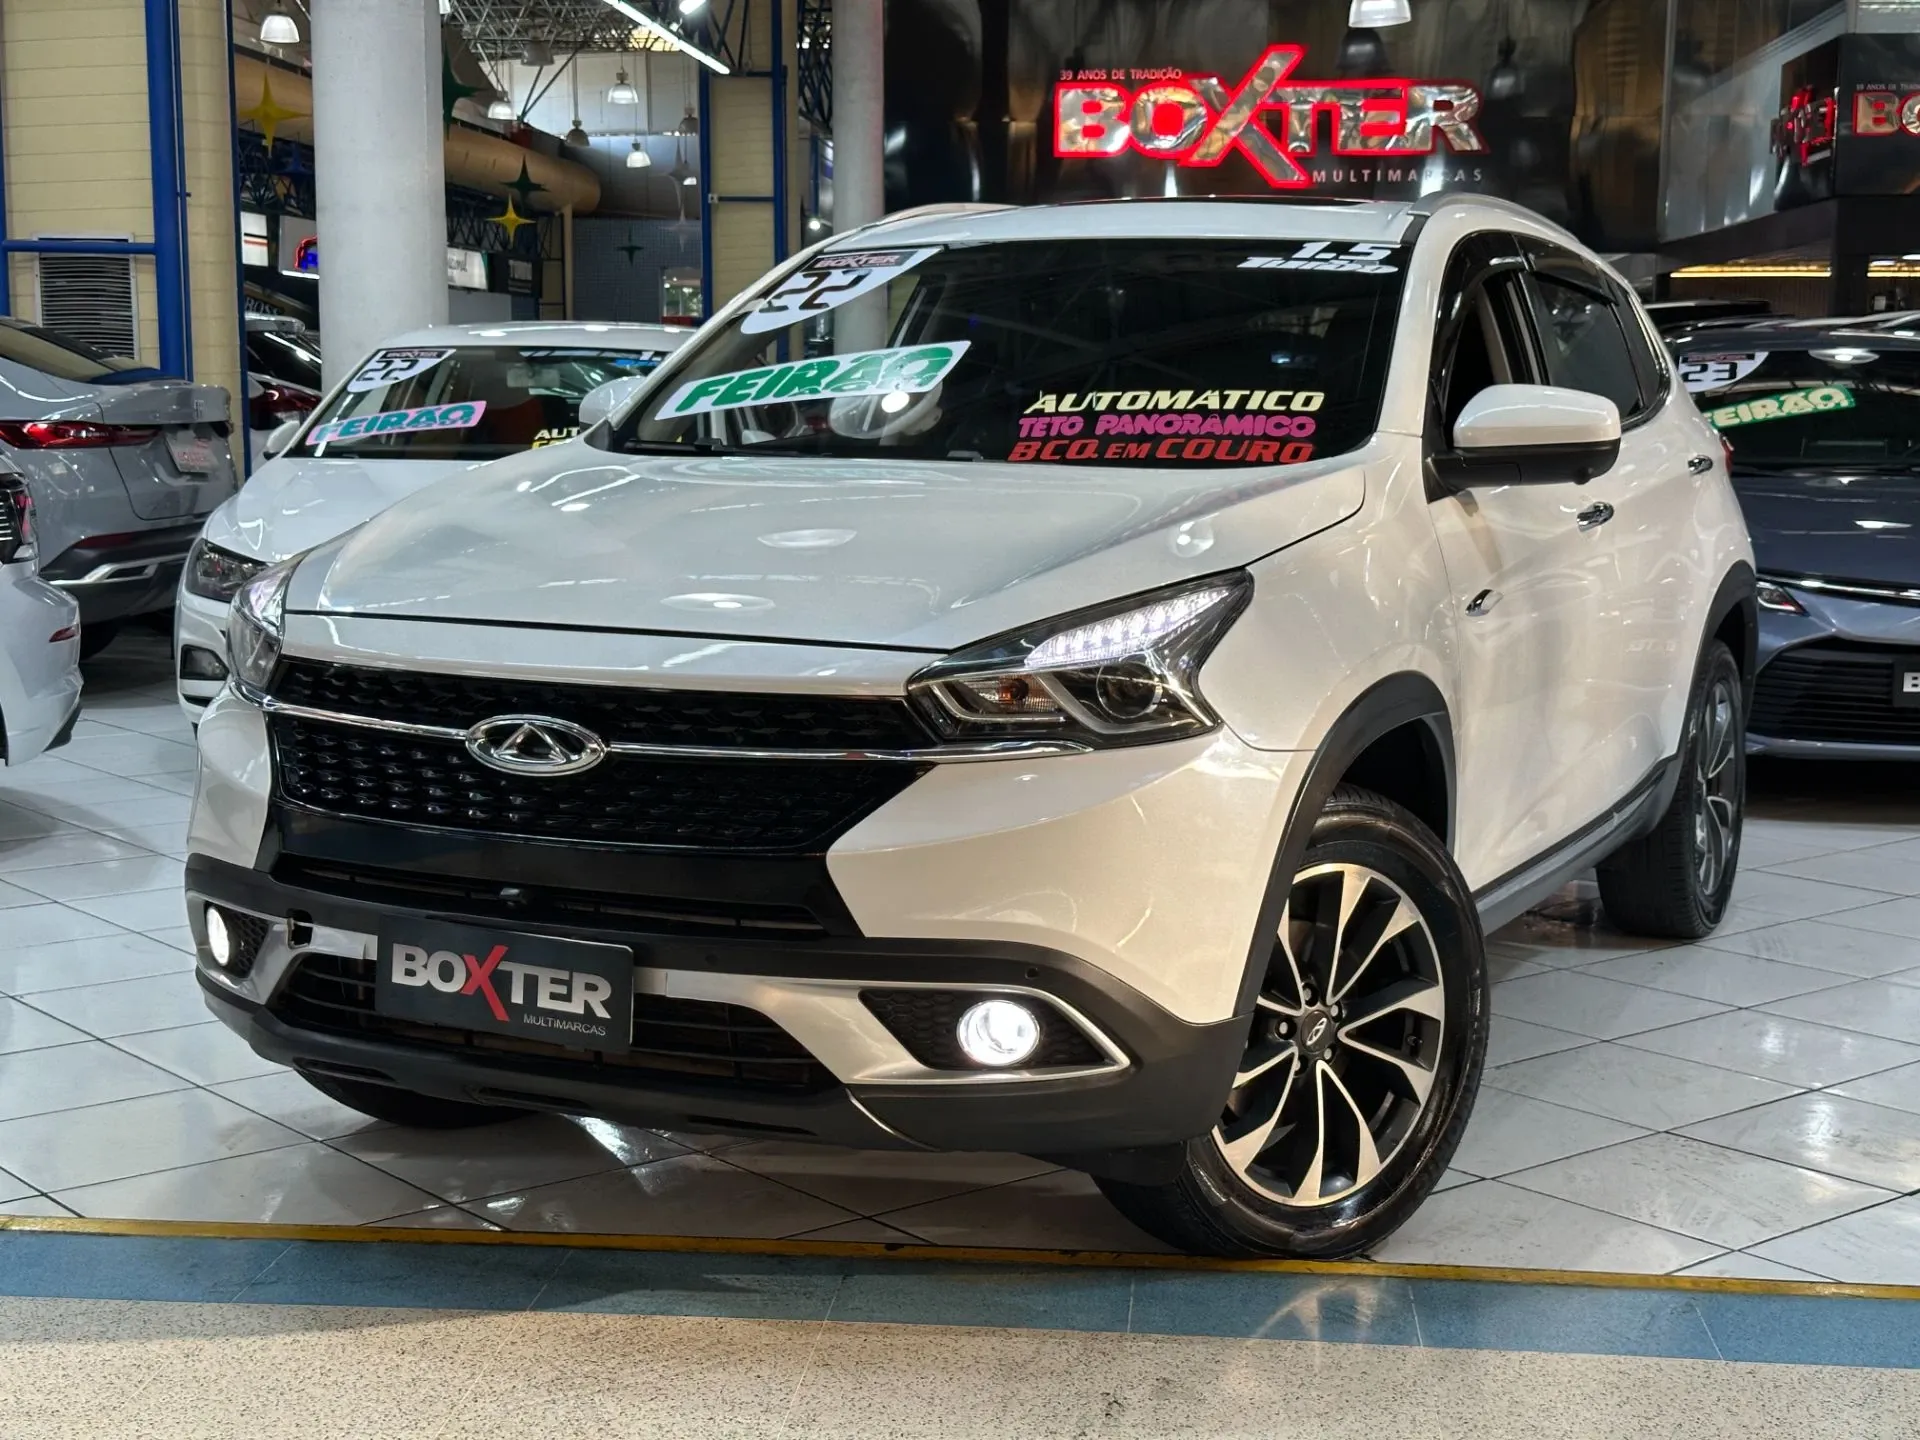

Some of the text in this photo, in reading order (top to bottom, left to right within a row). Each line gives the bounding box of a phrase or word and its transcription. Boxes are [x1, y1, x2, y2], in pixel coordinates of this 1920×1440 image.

[1060, 66, 1182, 81] 39 ANOS DE TRADIÇÃO
[1054, 44, 1489, 188] BOXTER
[1312, 168, 1482, 184] MULTIMARCAS
[814, 254, 900, 268] BOXTER
[1292, 241, 1401, 261] 1.5
[758, 271, 873, 314] 22
[355, 360, 420, 381] 22
[674, 346, 953, 413] FEIRÃO
[1681, 361, 1738, 382] 23
[1018, 413, 1317, 437] TETO PANORÂMICO
[1104, 442, 1153, 459] EM
[1155, 438, 1314, 464] COURO
[392, 943, 612, 1021] BOXTER
[523, 1013, 607, 1036] MULTIMARCAS
